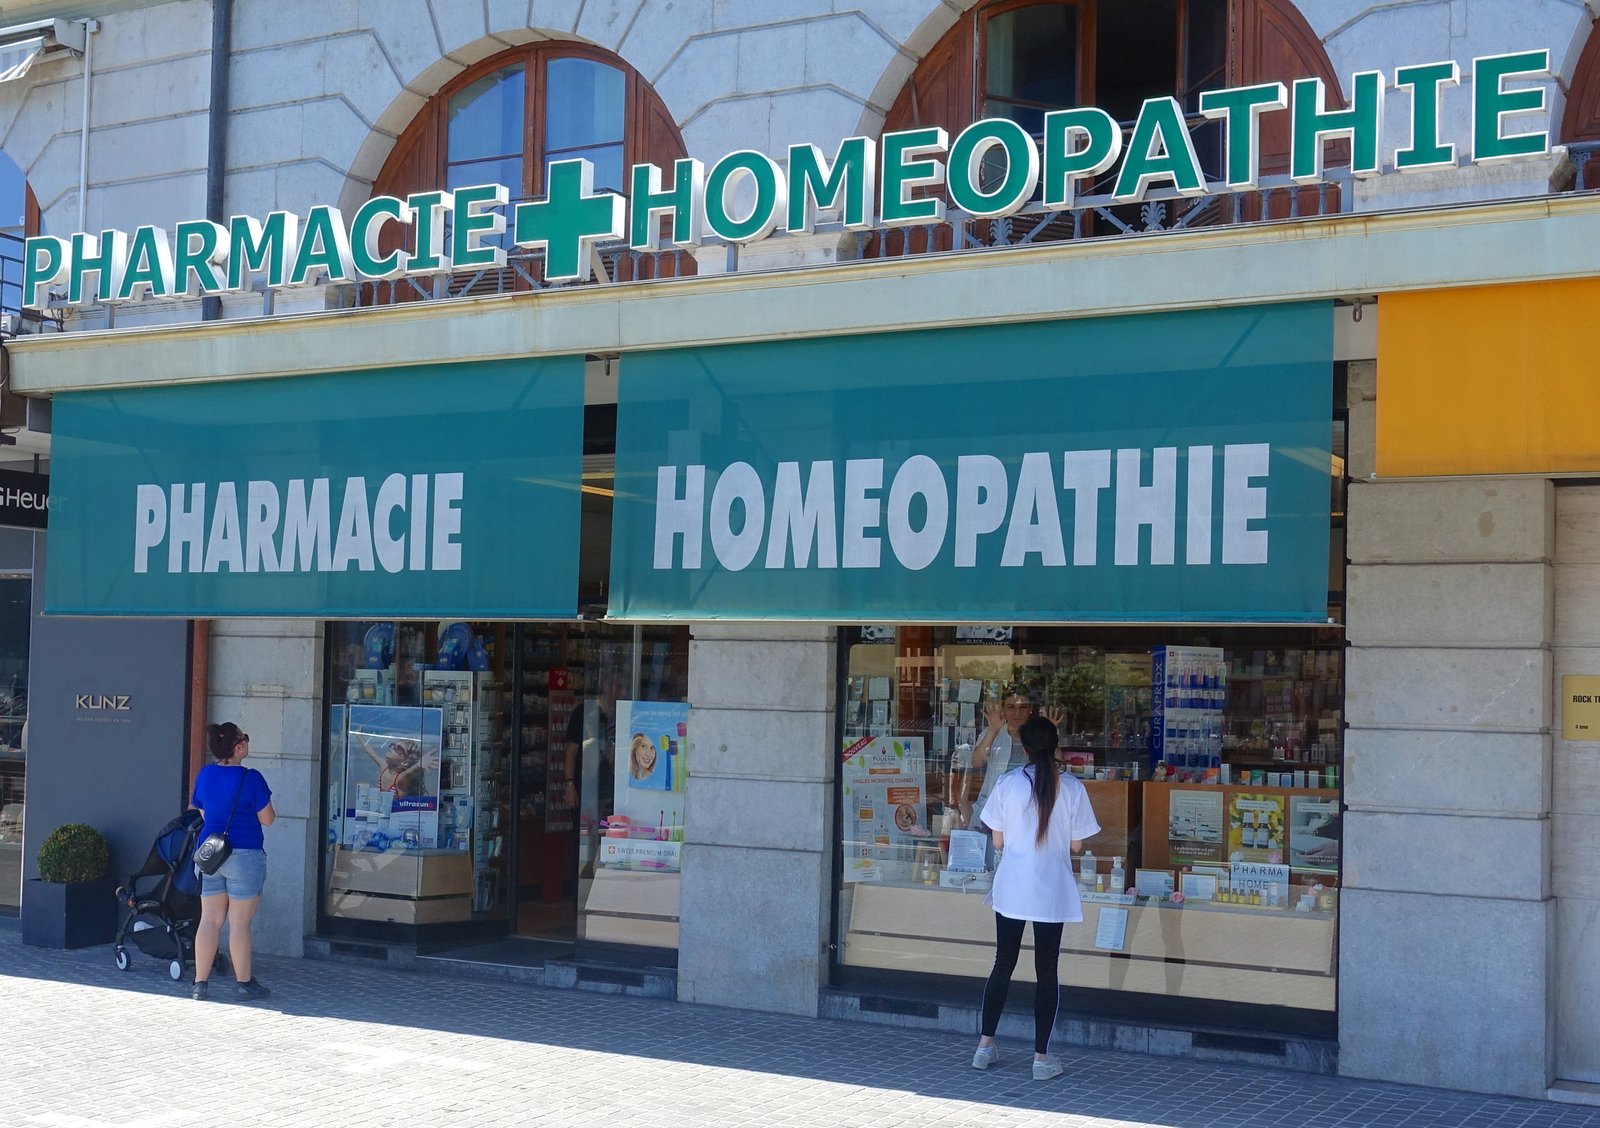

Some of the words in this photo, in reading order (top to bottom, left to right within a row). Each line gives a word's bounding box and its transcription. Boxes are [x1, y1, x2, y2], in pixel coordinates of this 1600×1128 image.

[22, 183, 509, 311] PHARMACIE
[629, 48, 1551, 252] HOMEOPATHIE
[653, 443, 1270, 571] HOMEOPATHIE
[134, 472, 464, 574] PHARMACIE
[75, 694, 131, 710] KUNZ
[1153, 661, 1164, 750] CURAPROX
[1572, 695, 1592, 703] ROCK
[399, 800, 429, 808] ultrasun
[617, 847, 634, 855] SWISS
[635, 848, 662, 856] PREMIUM
[663, 850, 678, 858] ORAL
[1233, 864, 1284, 877] PHARMA
[1238, 879, 1269, 890] HOME
